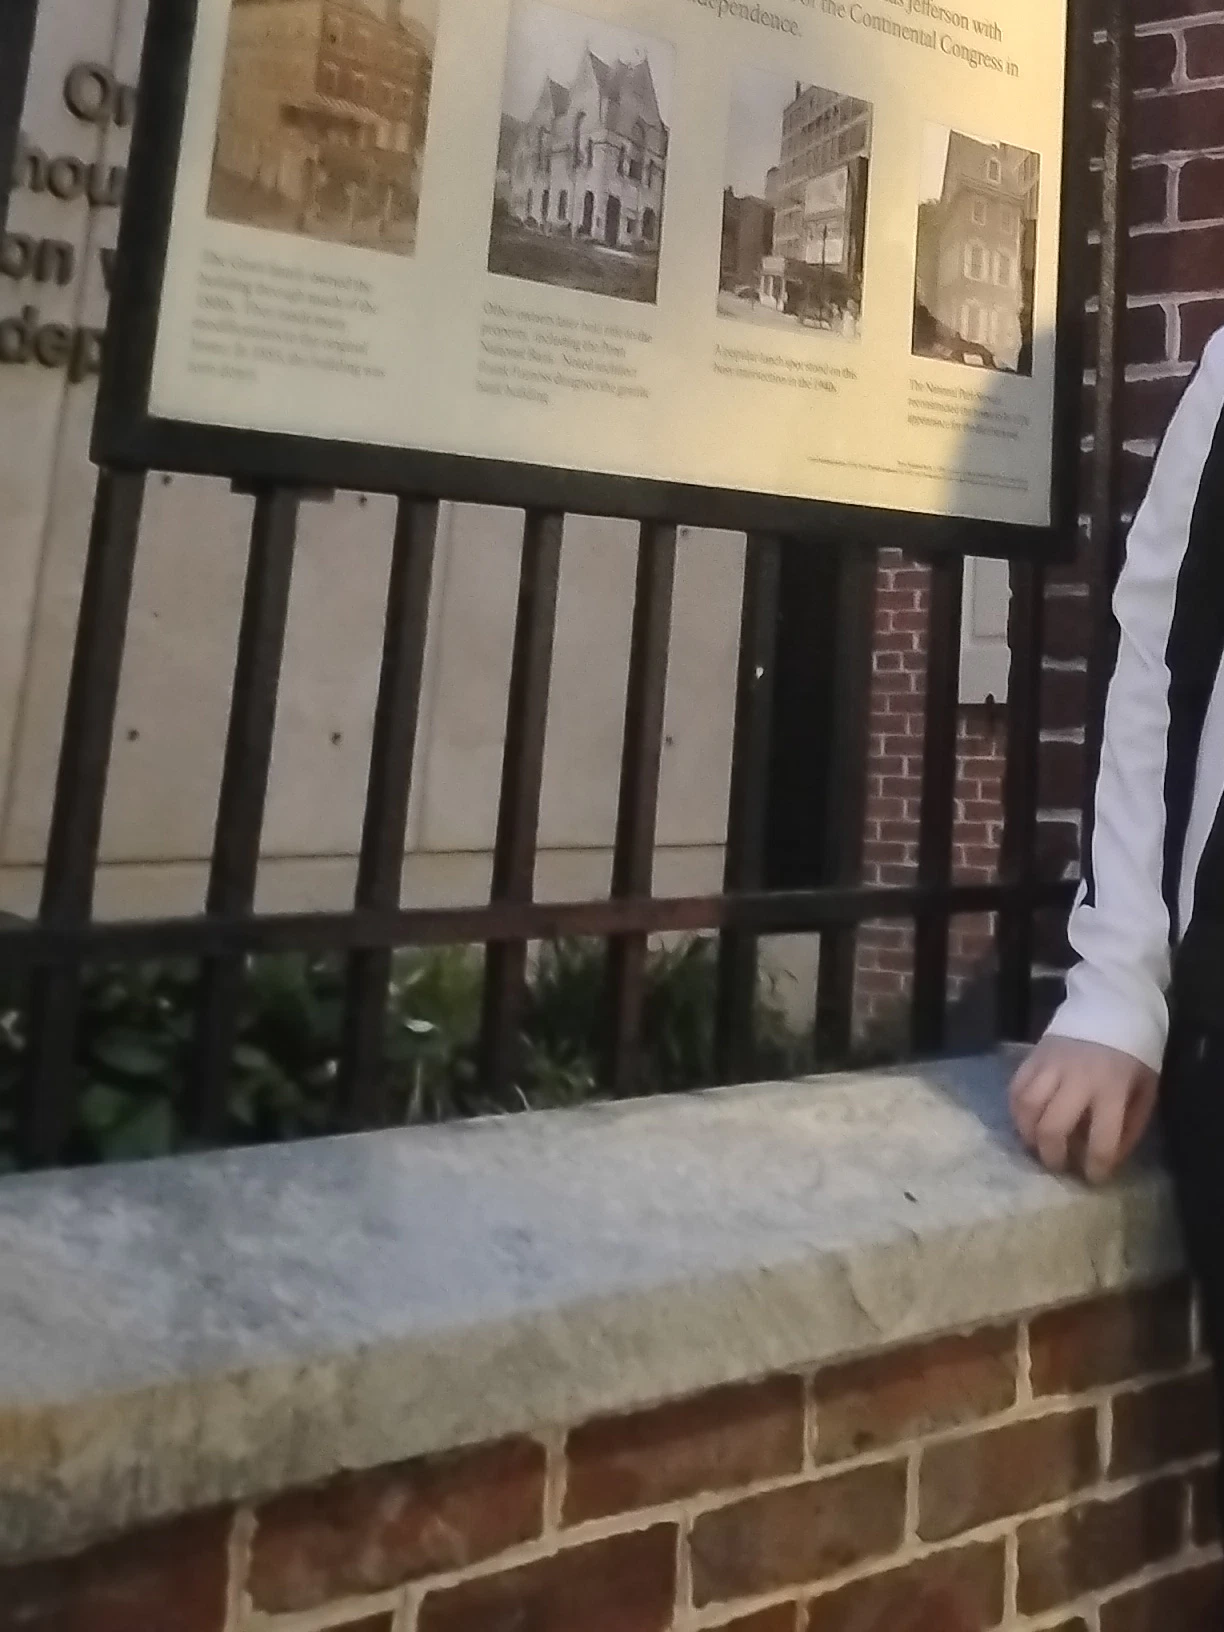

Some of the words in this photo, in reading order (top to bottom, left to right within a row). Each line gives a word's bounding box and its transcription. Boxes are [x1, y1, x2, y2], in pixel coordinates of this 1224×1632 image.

[849, 3, 937, 51] Continental
[939, 35, 1004, 73] Congress
[1006, 55, 1020, 78] in
[972, 18, 1003, 43] with
